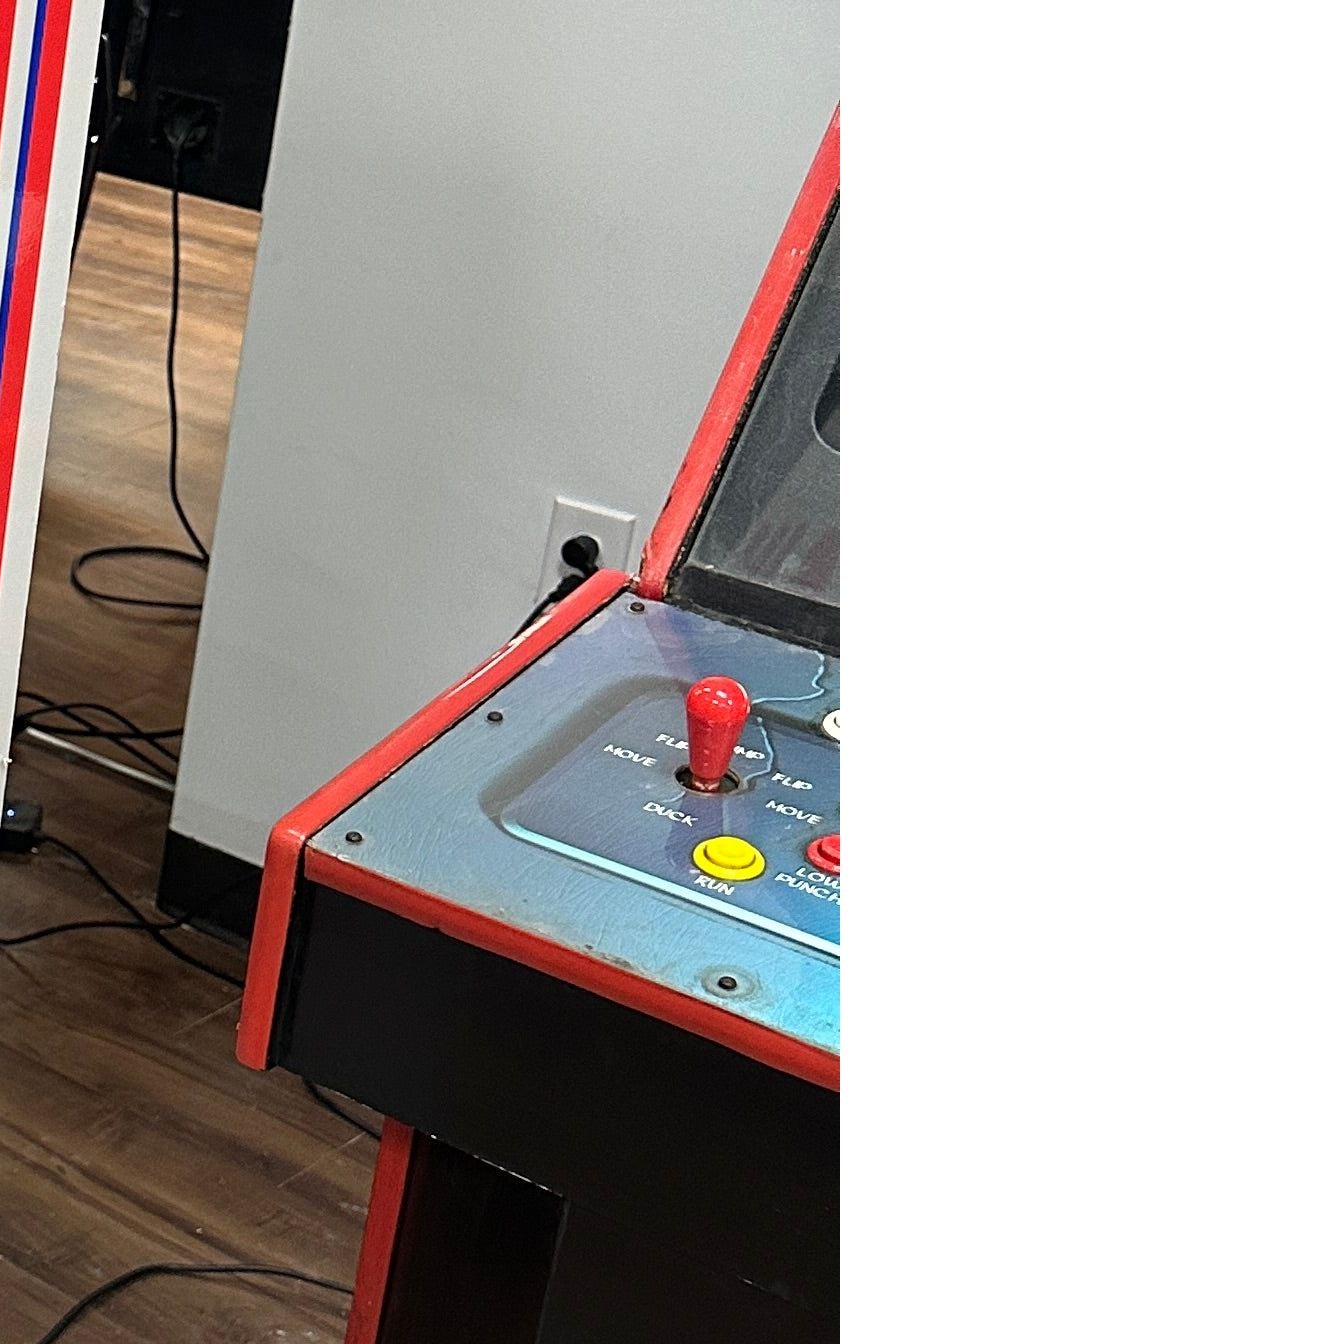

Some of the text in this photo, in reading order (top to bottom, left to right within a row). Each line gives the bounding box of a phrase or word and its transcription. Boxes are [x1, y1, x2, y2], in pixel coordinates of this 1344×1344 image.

[603, 743, 658, 767] MOVE
[771, 771, 813, 791] FLIP
[642, 801, 700, 827] DUCK
[765, 800, 824, 825] MOVE
[693, 874, 737, 896] RUN
[795, 867, 840, 889] LOW
